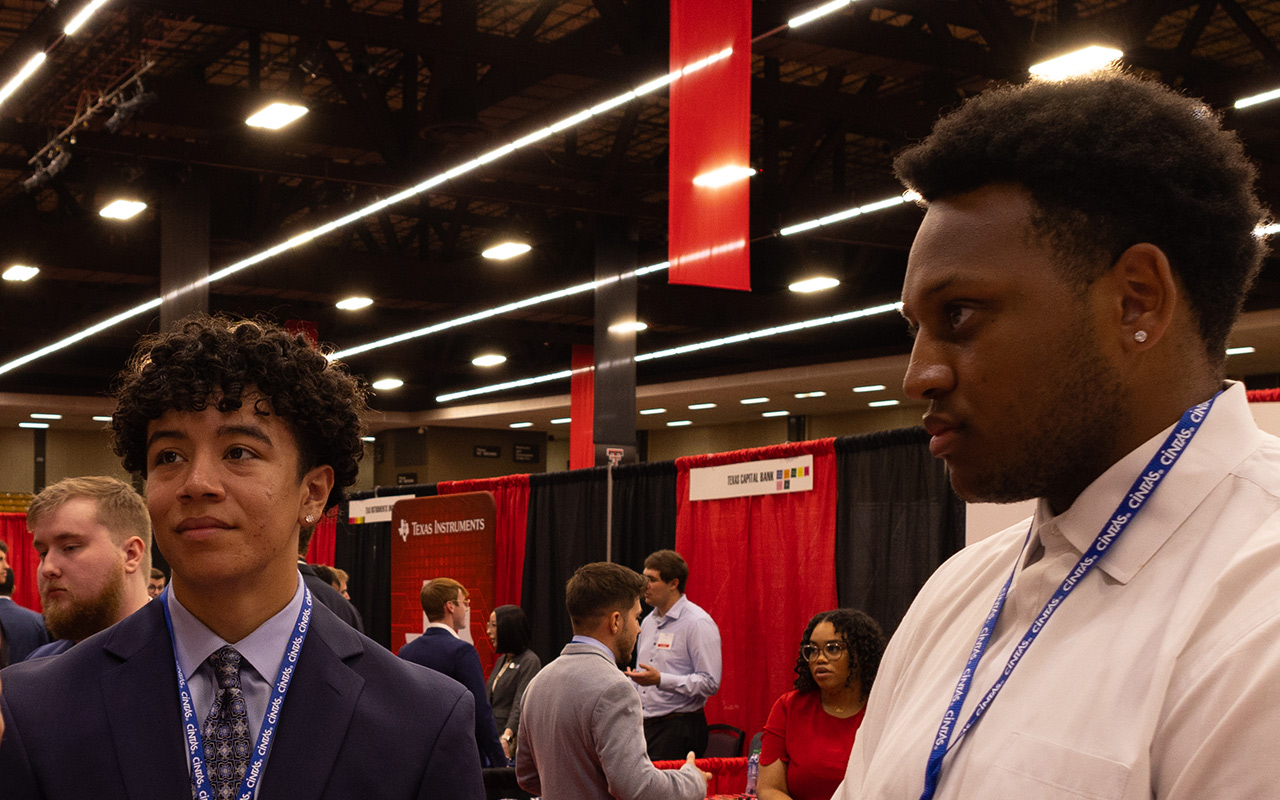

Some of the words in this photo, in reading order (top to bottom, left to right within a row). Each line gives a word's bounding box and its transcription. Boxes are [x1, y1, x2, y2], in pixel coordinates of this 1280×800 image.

[727, 475, 740, 486] TEXAS
[740, 472, 759, 485] CAPITAL
[760, 471, 774, 482] BANK
